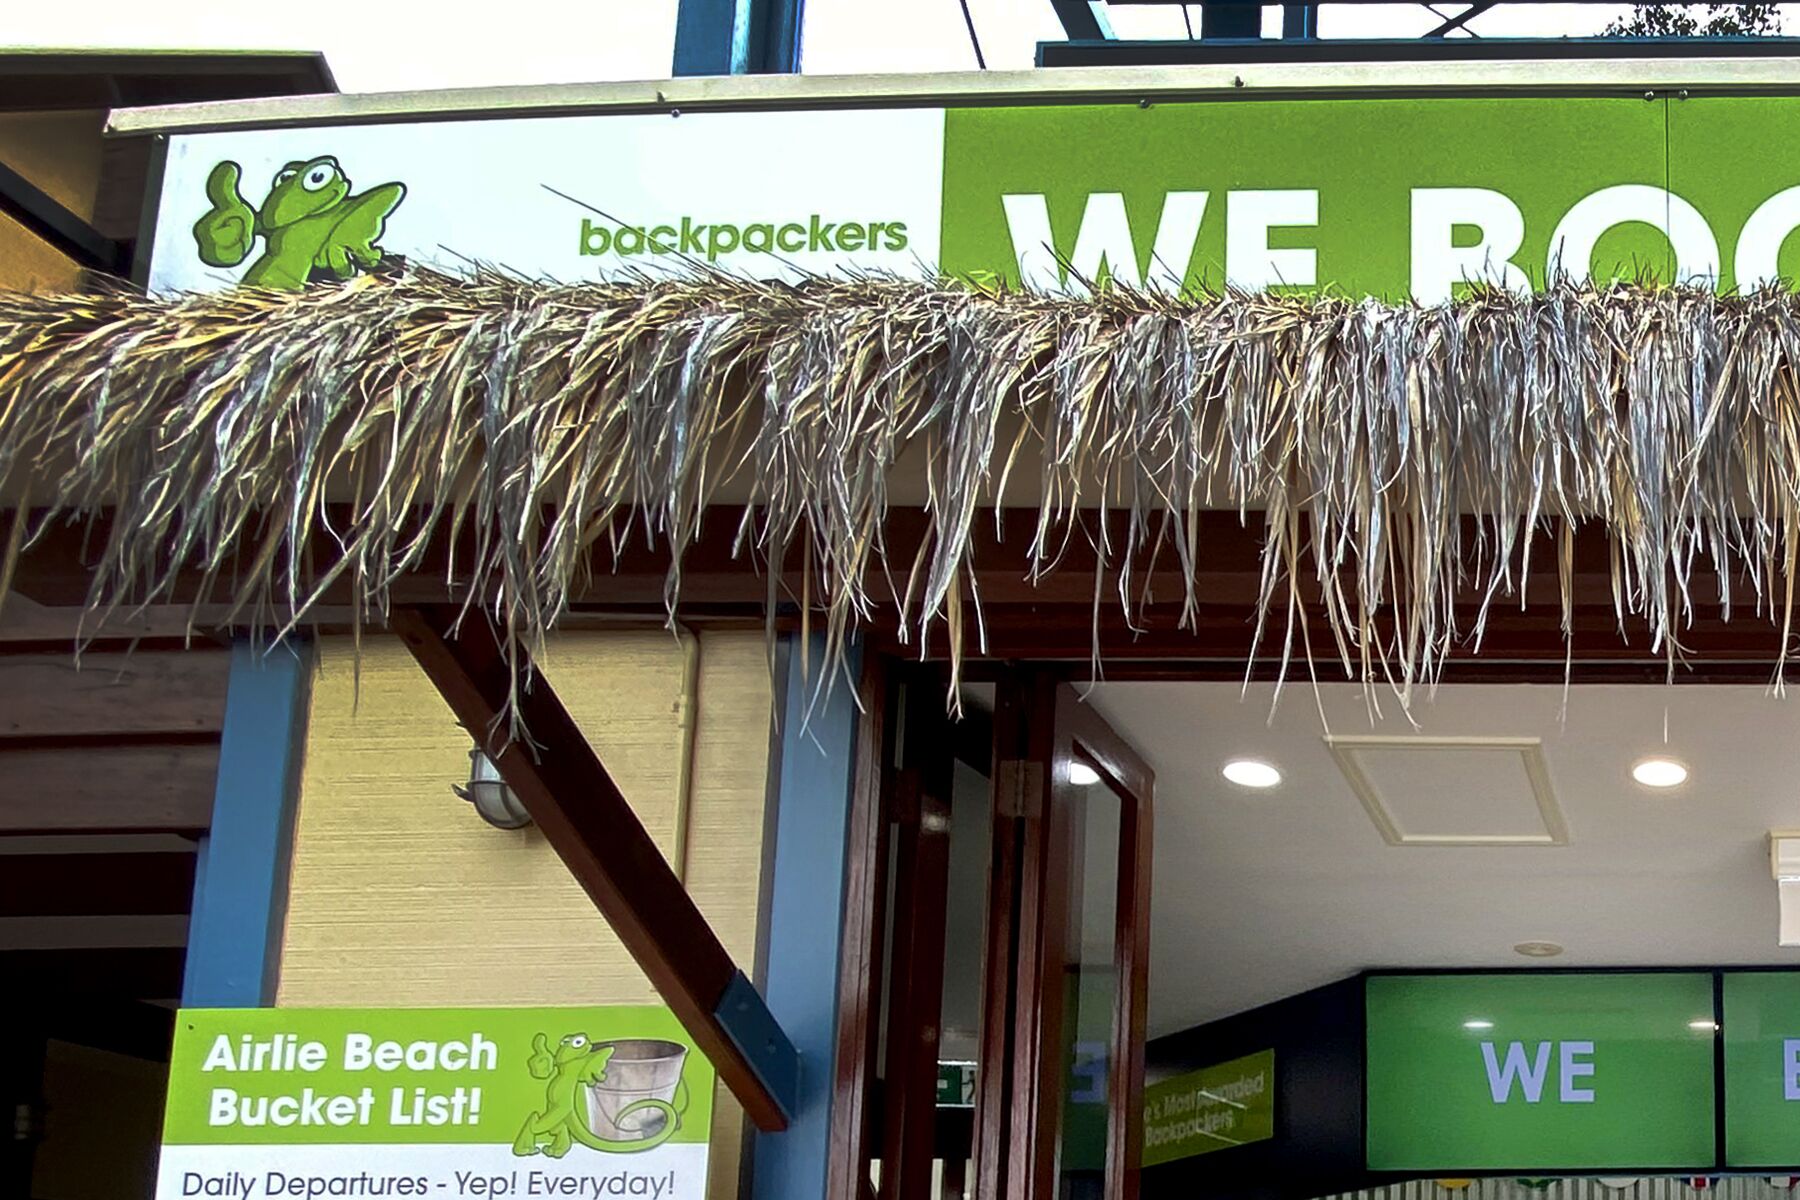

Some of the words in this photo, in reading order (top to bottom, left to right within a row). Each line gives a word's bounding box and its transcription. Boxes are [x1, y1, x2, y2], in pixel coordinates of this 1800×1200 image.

[580, 214, 909, 262] backpackers
[1001, 190, 1319, 298] WE
[202, 1033, 327, 1072] Airlie
[343, 1032, 498, 1072] Beach
[1481, 1040, 1596, 1103] WE
[209, 1088, 374, 1127] Bucket
[390, 1088, 482, 1125] List!
[182, 1171, 256, 1200] Daily
[266, 1172, 428, 1200] Departures
[454, 1171, 517, 1200] Yep!
[528, 1170, 675, 1200] Everyday!
